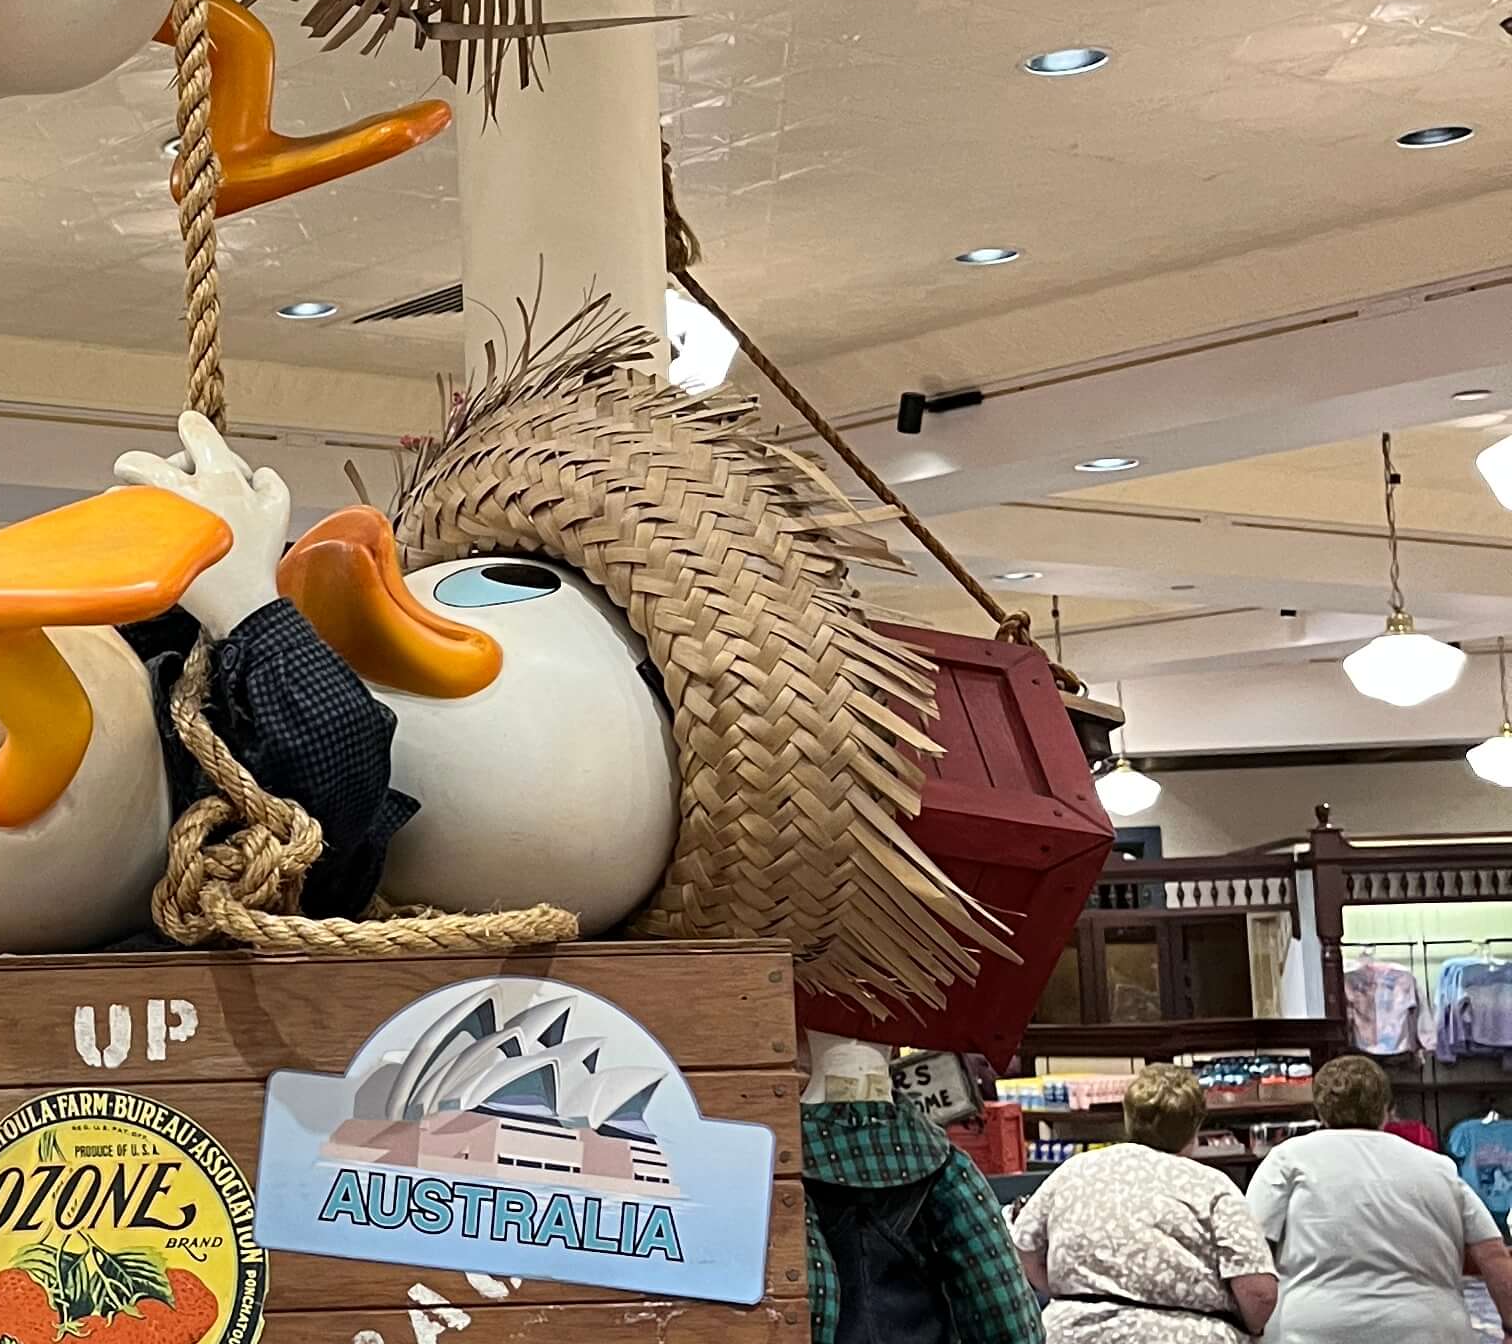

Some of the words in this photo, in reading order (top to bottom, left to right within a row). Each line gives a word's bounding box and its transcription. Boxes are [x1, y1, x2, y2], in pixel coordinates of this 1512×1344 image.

[73, 999, 200, 1069] UP
[57, 1092, 108, 1119] FARM
[113, 1095, 196, 1147] BUREAU
[74, 1144, 113, 1158] PRODUCE
[117, 1143, 127, 1157] OF
[318, 1168, 685, 1262] AUSTRALIA
[165, 1236, 223, 1262] BRAND
